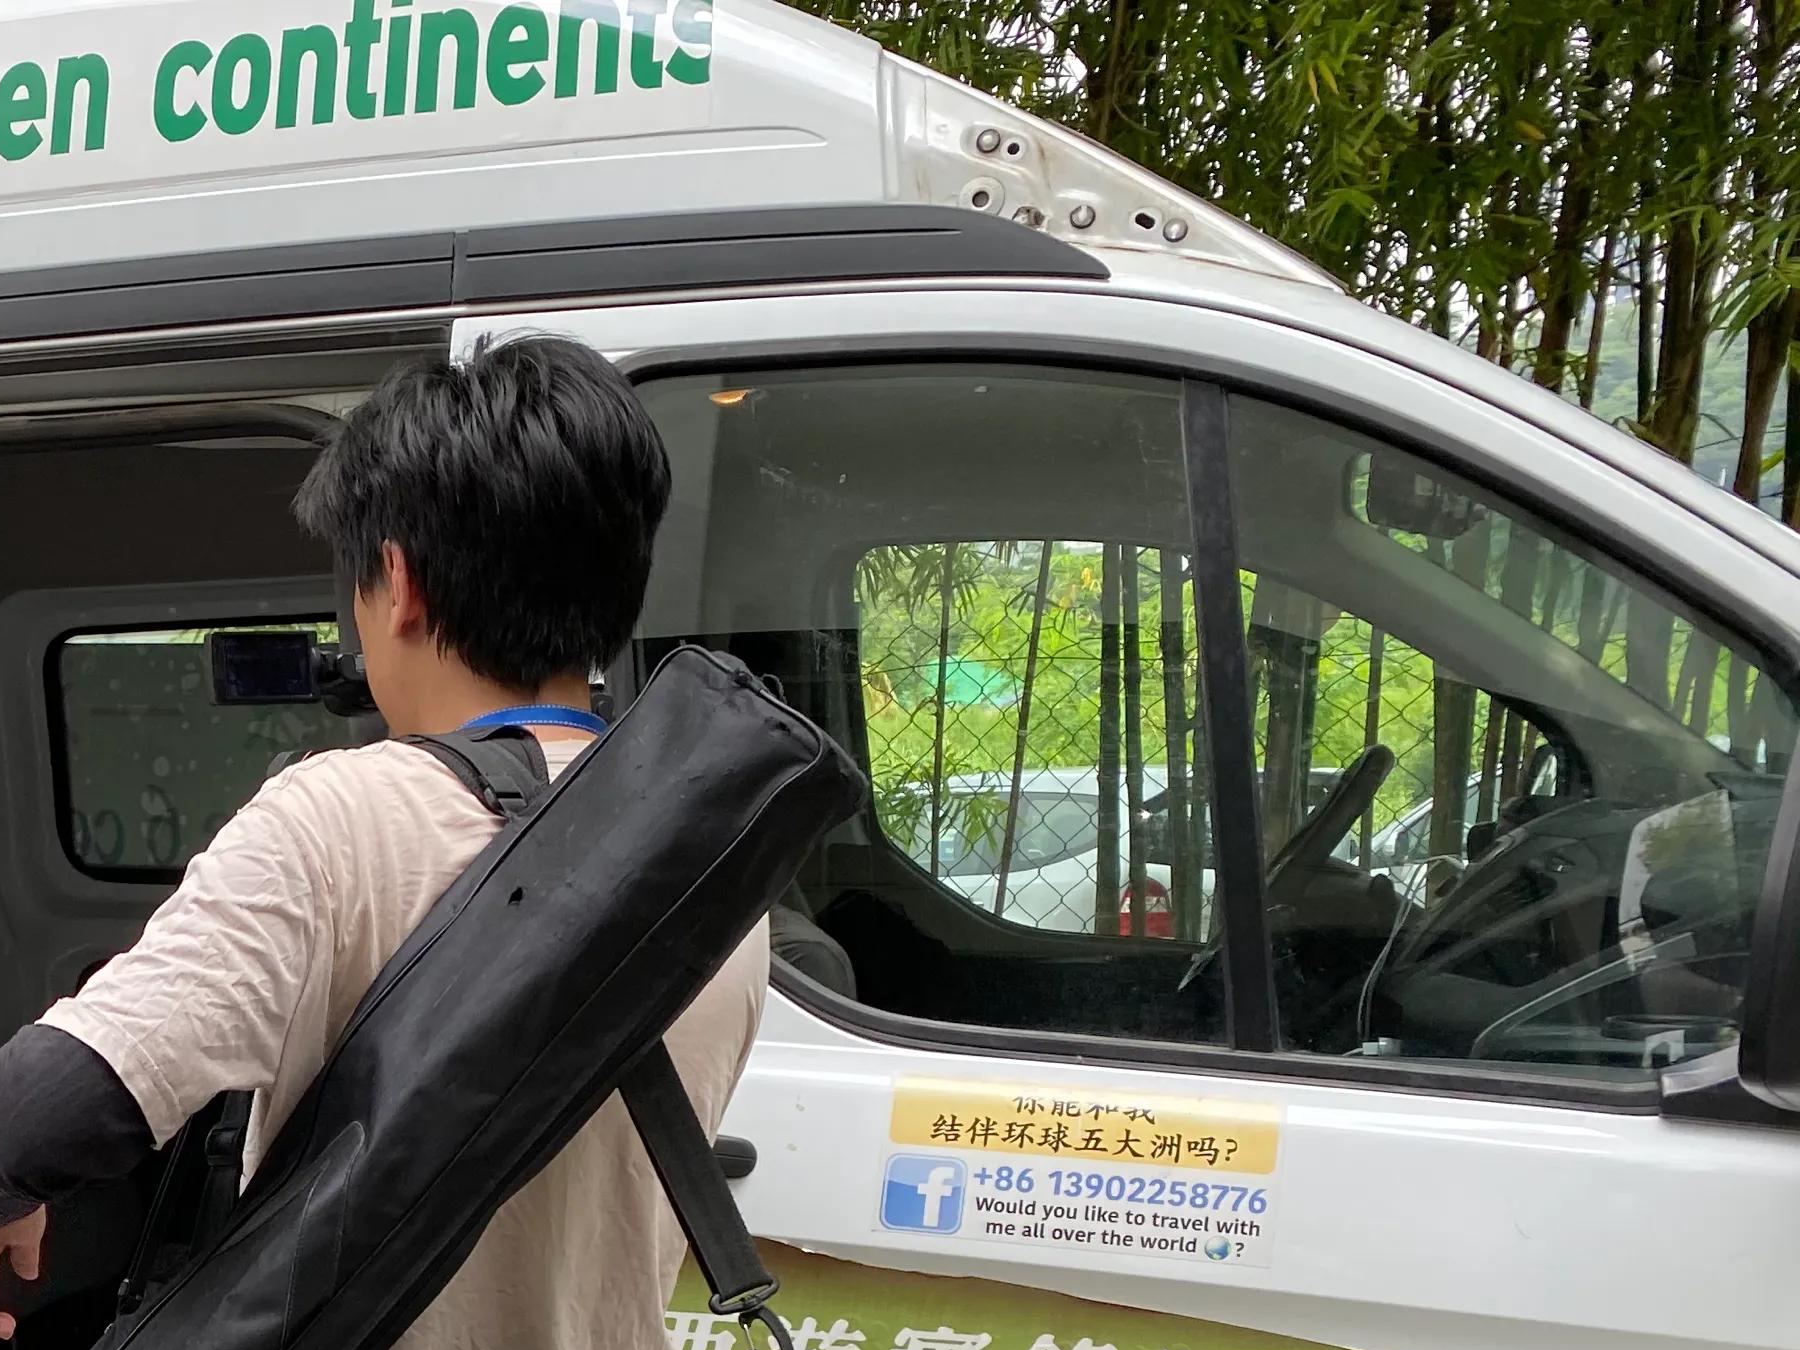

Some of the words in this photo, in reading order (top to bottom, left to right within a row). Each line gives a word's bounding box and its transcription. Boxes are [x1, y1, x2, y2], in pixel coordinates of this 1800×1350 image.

[153, 0, 713, 144] continents
[973, 1166, 1034, 1194] +86
[1048, 1170, 1268, 1215] 13902258776
[976, 1196, 1036, 1217] Would
[1042, 1204, 1078, 1221] you
[1084, 1205, 1119, 1224] like
[1125, 1210, 1146, 1226] to
[1152, 1210, 1209, 1233] travel
[1216, 1219, 1261, 1238] with
[986, 1220, 1016, 1236] me
[1022, 1222, 1045, 1239] all
[1052, 1227, 1096, 1243] over
[1101, 1228, 1134, 1247] the
[1140, 1234, 1197, 1253] world
